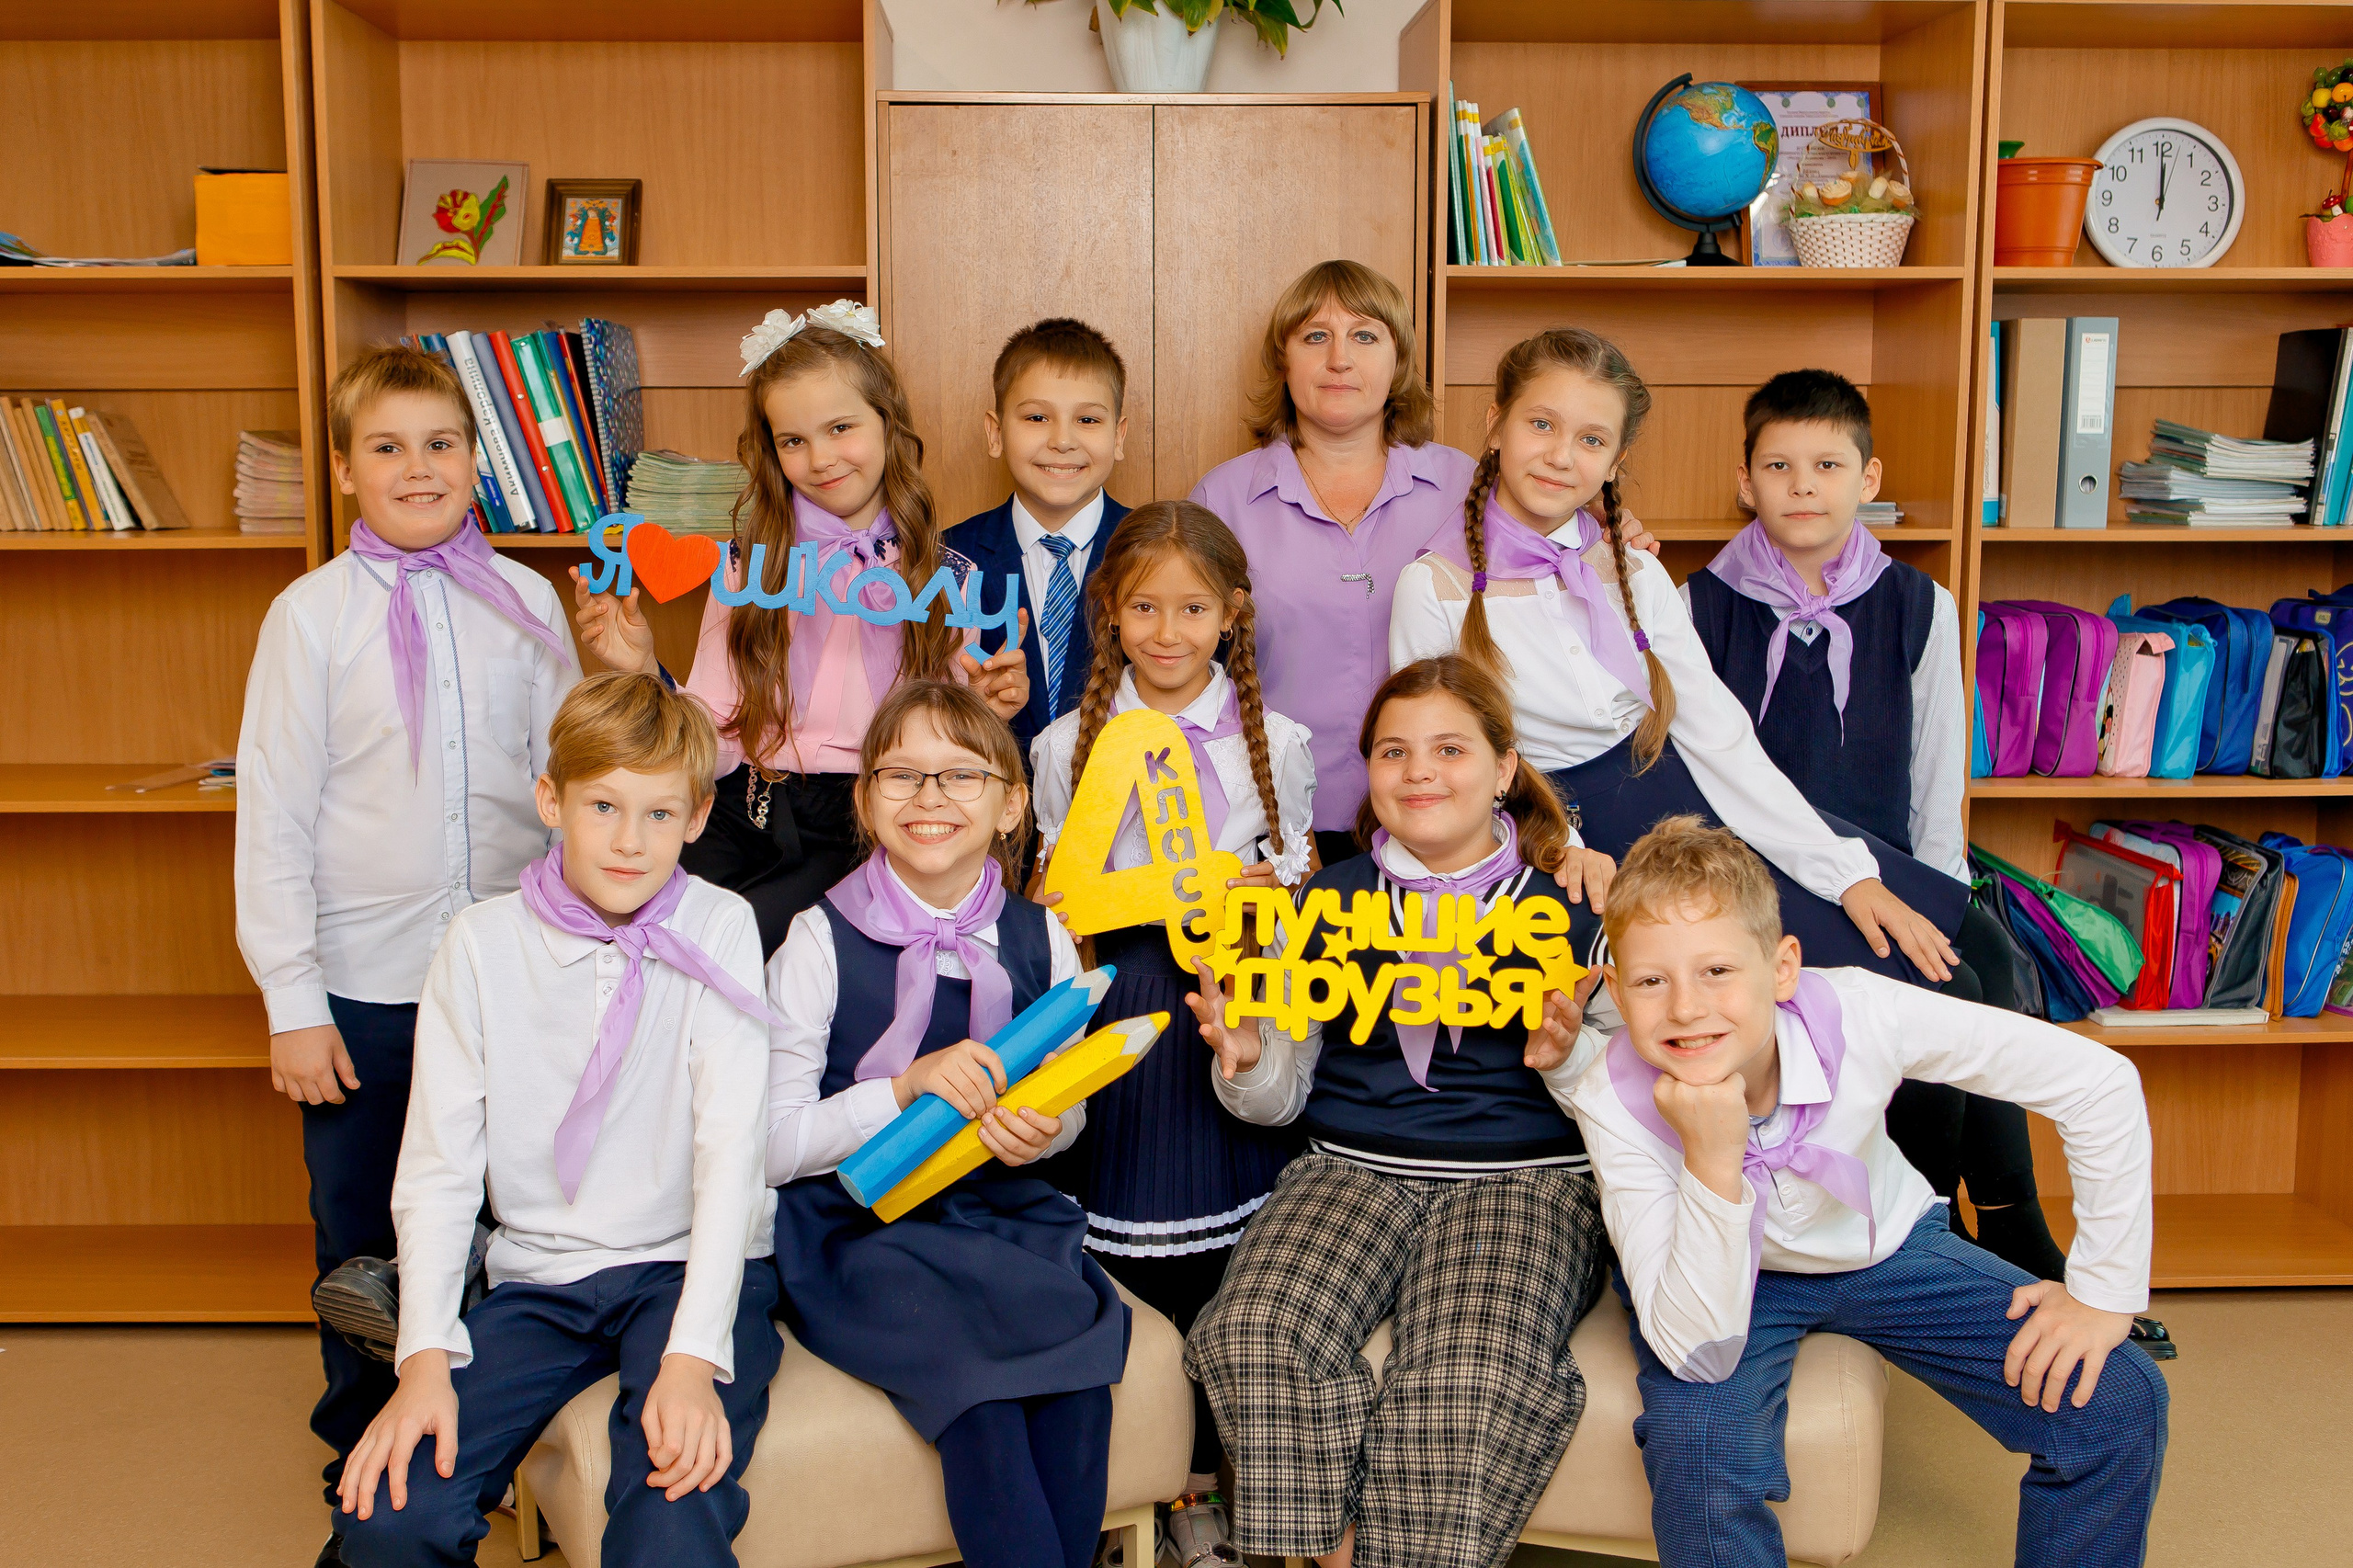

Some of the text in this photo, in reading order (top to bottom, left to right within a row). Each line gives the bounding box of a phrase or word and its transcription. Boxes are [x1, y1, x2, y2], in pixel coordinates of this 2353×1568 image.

[1780, 124, 1839, 139] ДИПЛ
[2129, 147, 2143, 164] 11
[2153, 141, 2172, 158] 12
[2187, 152, 2194, 168] 1
[2109, 165, 2127, 182] 10
[2200, 170, 2211, 187] 2
[2101, 189, 2112, 207] 9
[2207, 195, 2219, 211] 3
[2108, 217, 2119, 233] 8
[2199, 222, 2211, 237] 4
[2127, 237, 2138, 254] 7
[2151, 245, 2162, 262] 6
[2179, 239, 2190, 256] 5
[464, 358, 493, 426] Каролина
[579, 513, 644, 596] Я
